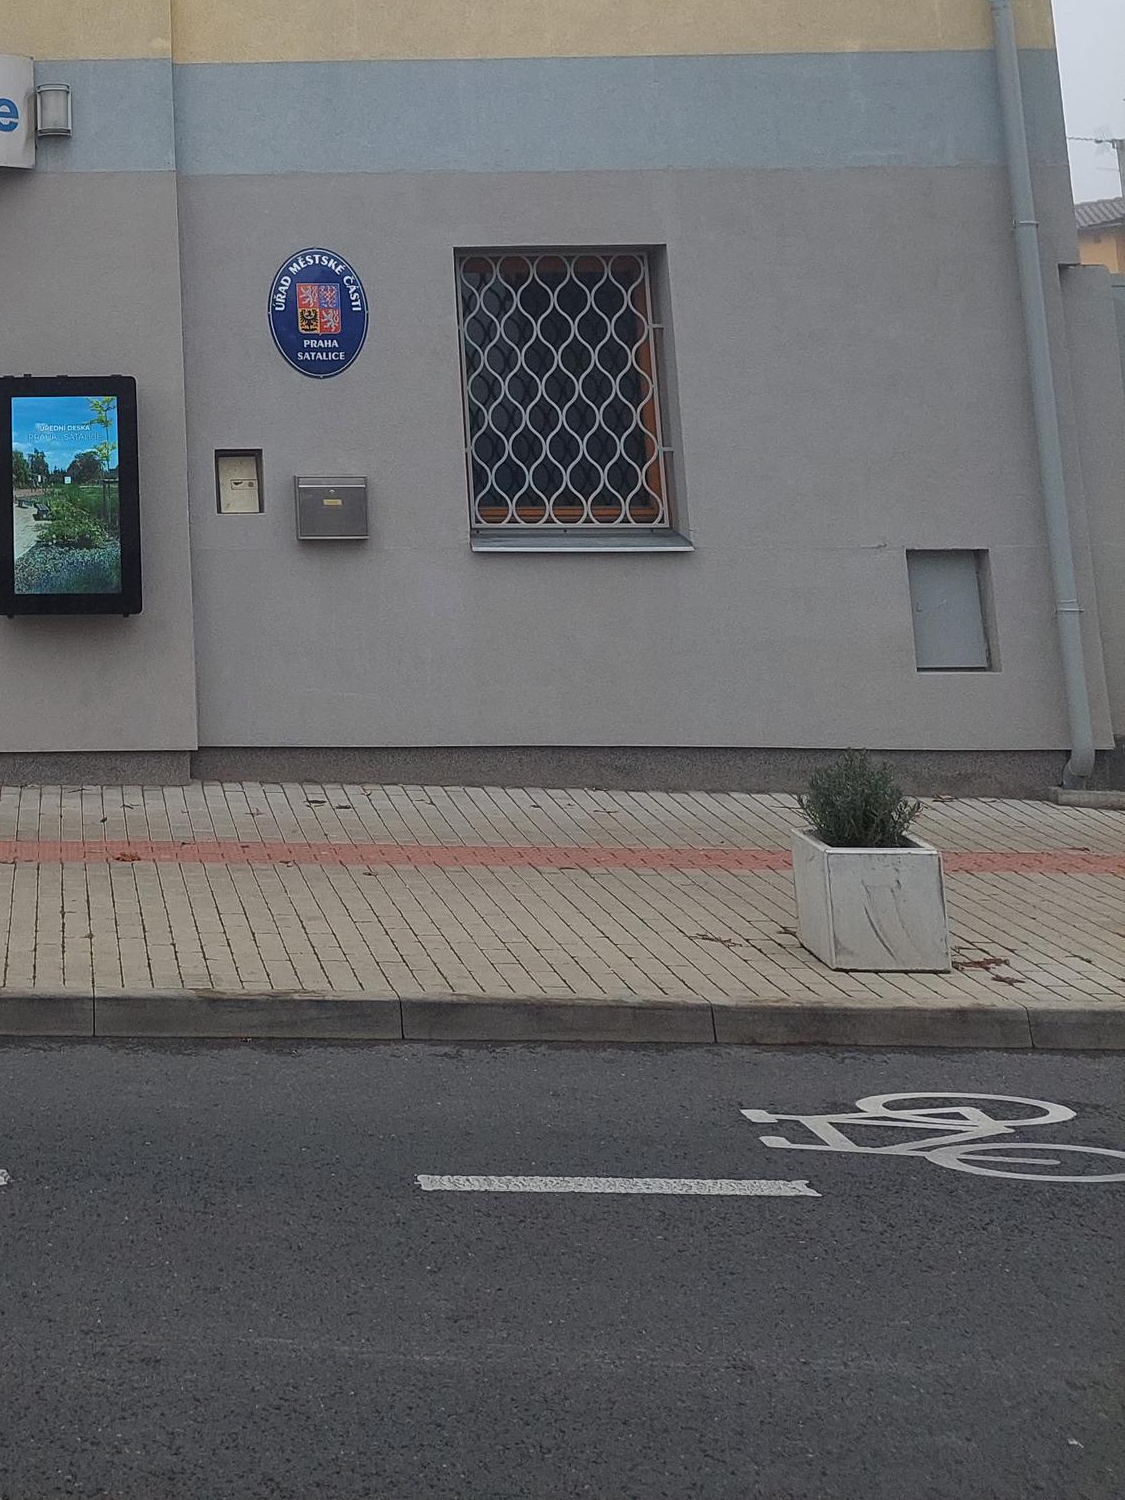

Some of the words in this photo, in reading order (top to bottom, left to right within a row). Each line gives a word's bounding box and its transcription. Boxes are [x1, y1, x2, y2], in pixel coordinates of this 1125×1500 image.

[273, 275, 292, 311] ÚŘAD
[288, 254, 346, 275] MĚSTSKÉ
[343, 275, 362, 311] ČÁSTI
[303, 339, 339, 348] PRAHA
[297, 351, 346, 361] SATALICE
